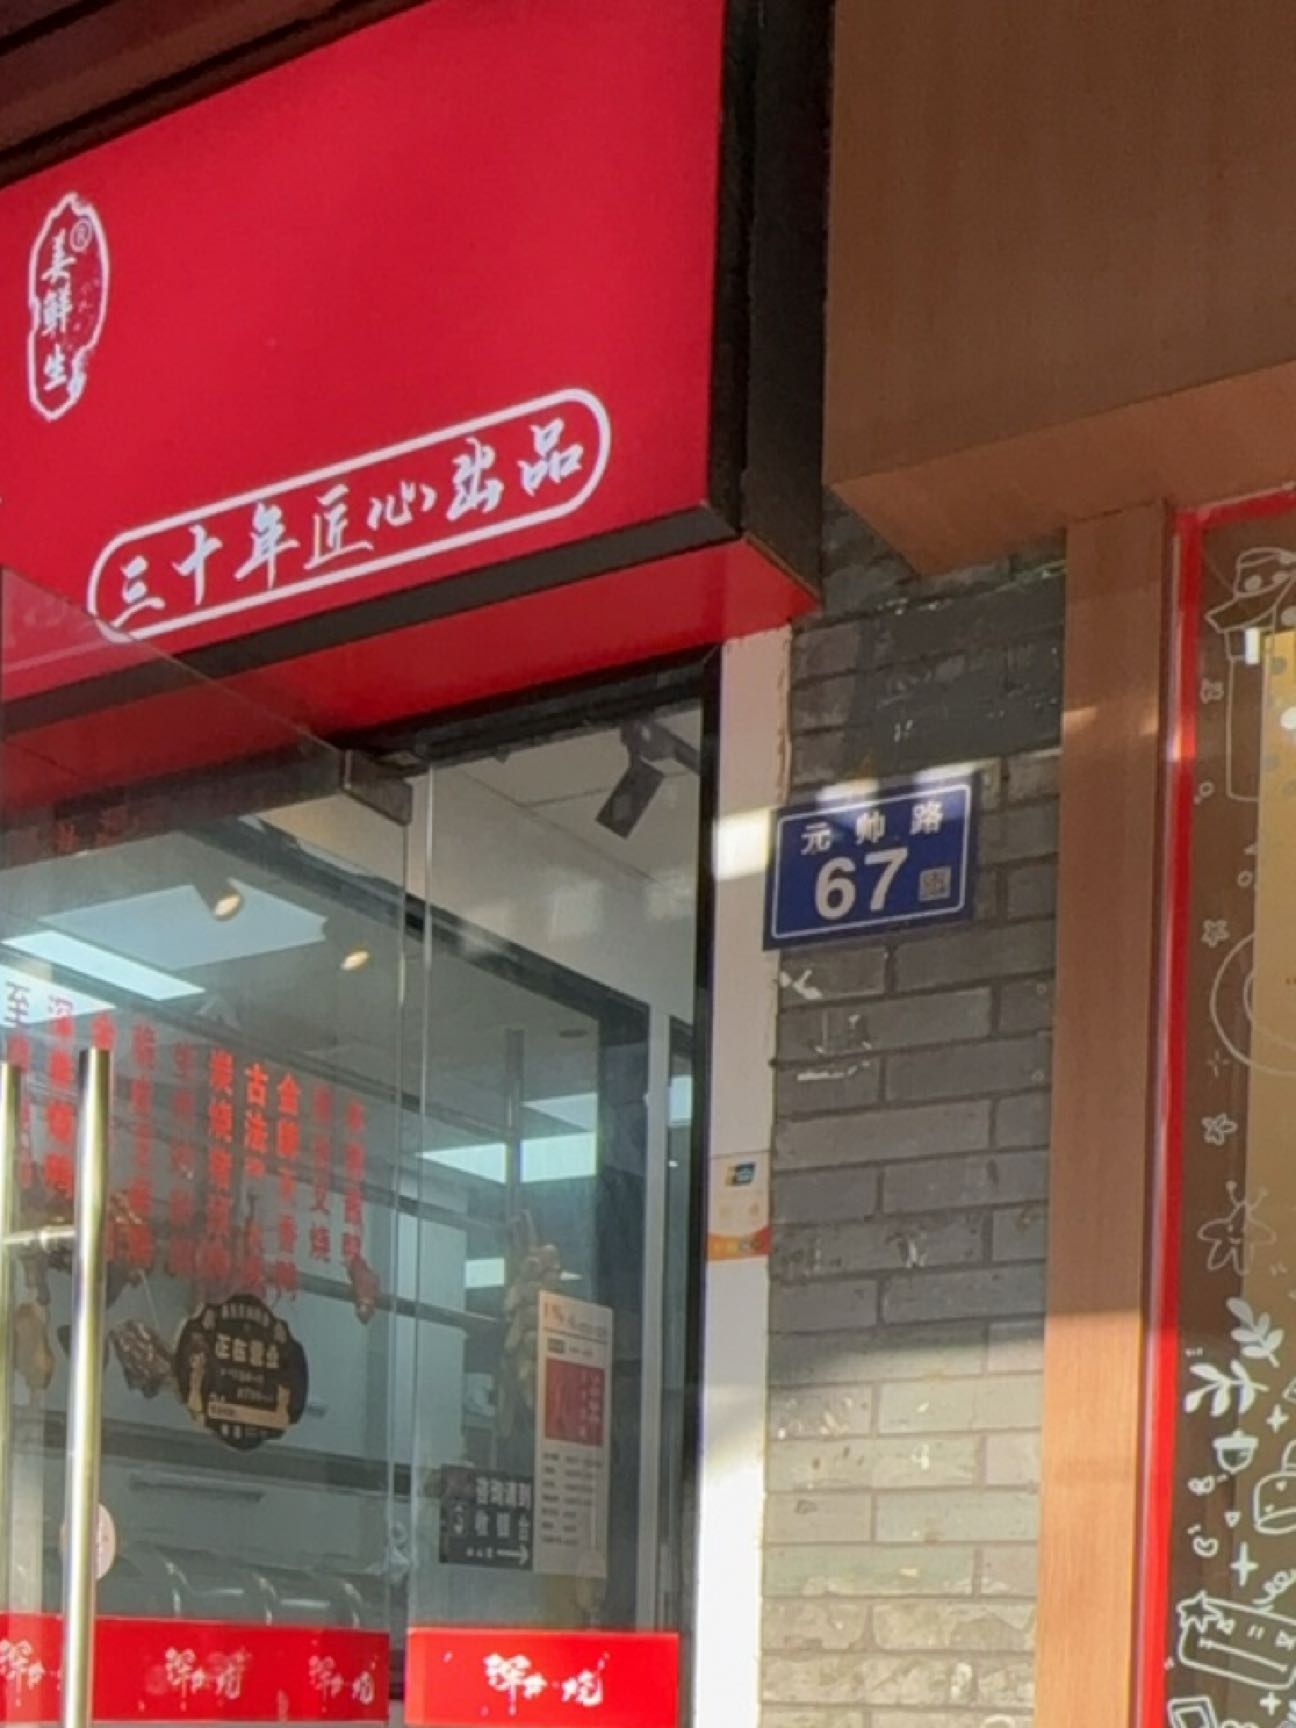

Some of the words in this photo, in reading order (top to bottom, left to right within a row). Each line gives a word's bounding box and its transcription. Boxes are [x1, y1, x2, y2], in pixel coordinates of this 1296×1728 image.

[108, 416, 585, 629] 三十年匠心出品
[800, 800, 945, 856] 元帅路
[814, 847, 908, 921] 67
